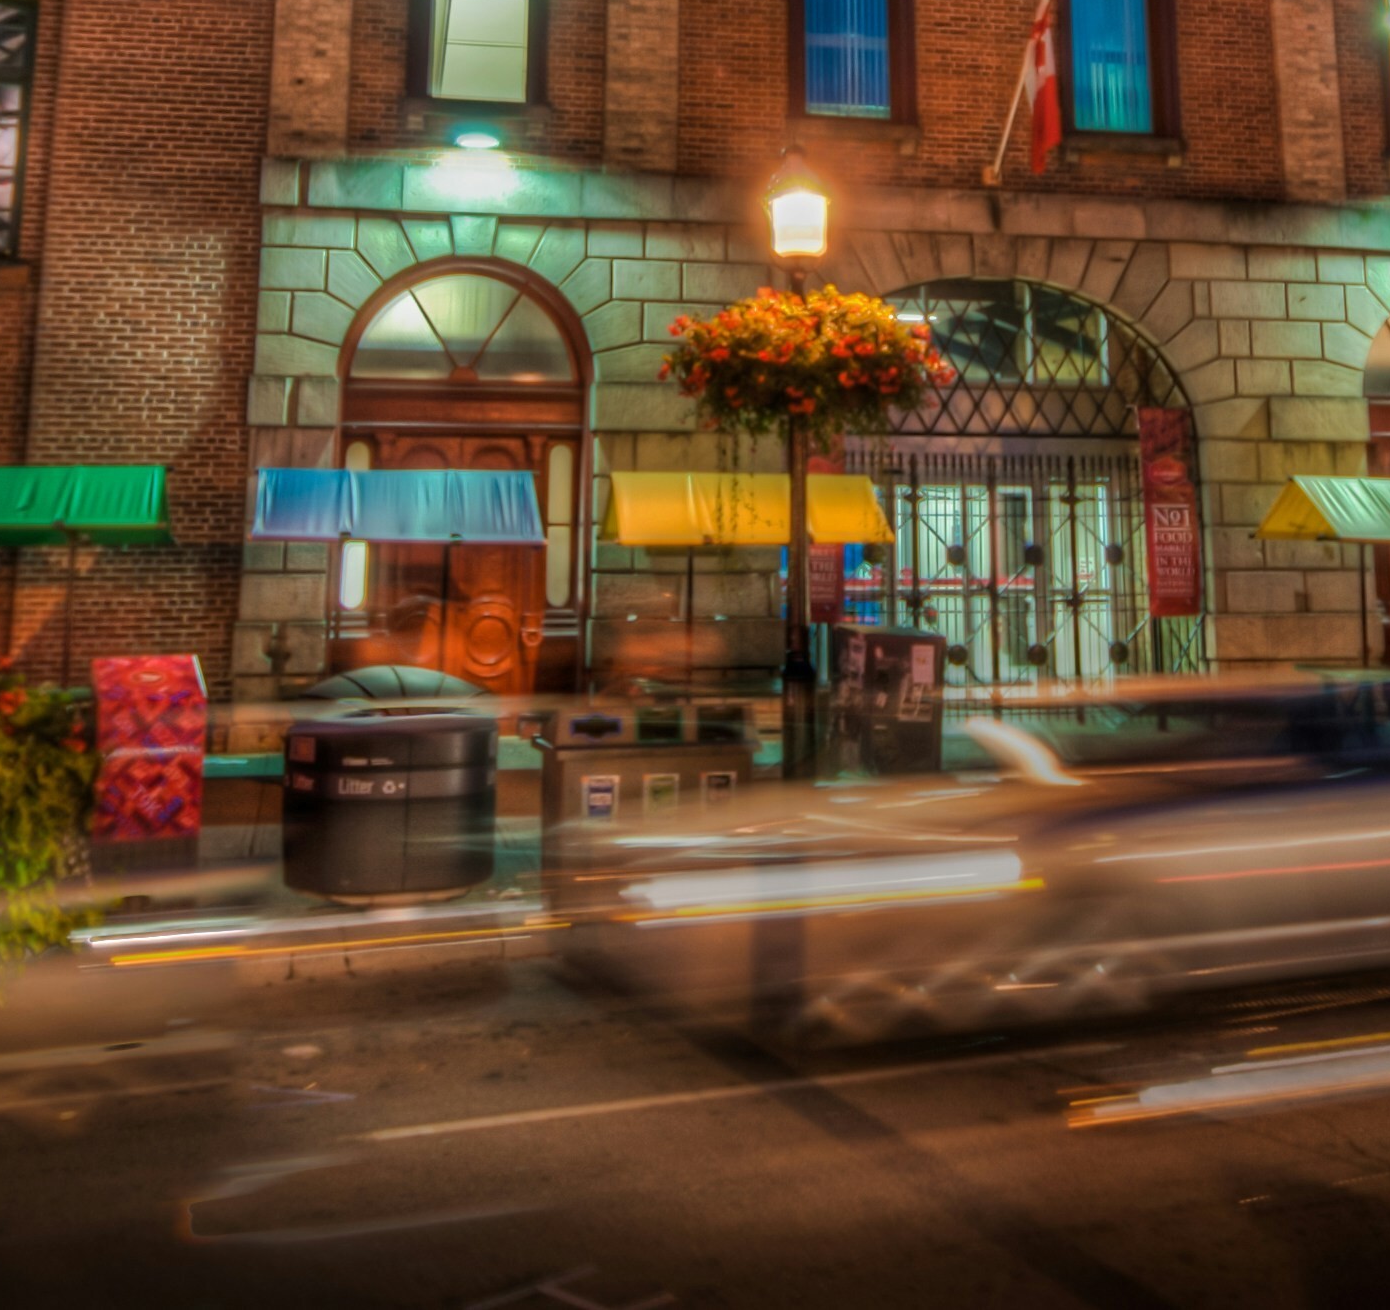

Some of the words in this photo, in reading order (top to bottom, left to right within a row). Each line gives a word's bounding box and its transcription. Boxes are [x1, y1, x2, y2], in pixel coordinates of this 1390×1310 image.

[1154, 531, 1193, 544] FOOD
[1172, 556, 1192, 566] THE
[337, 777, 375, 794] Litter
